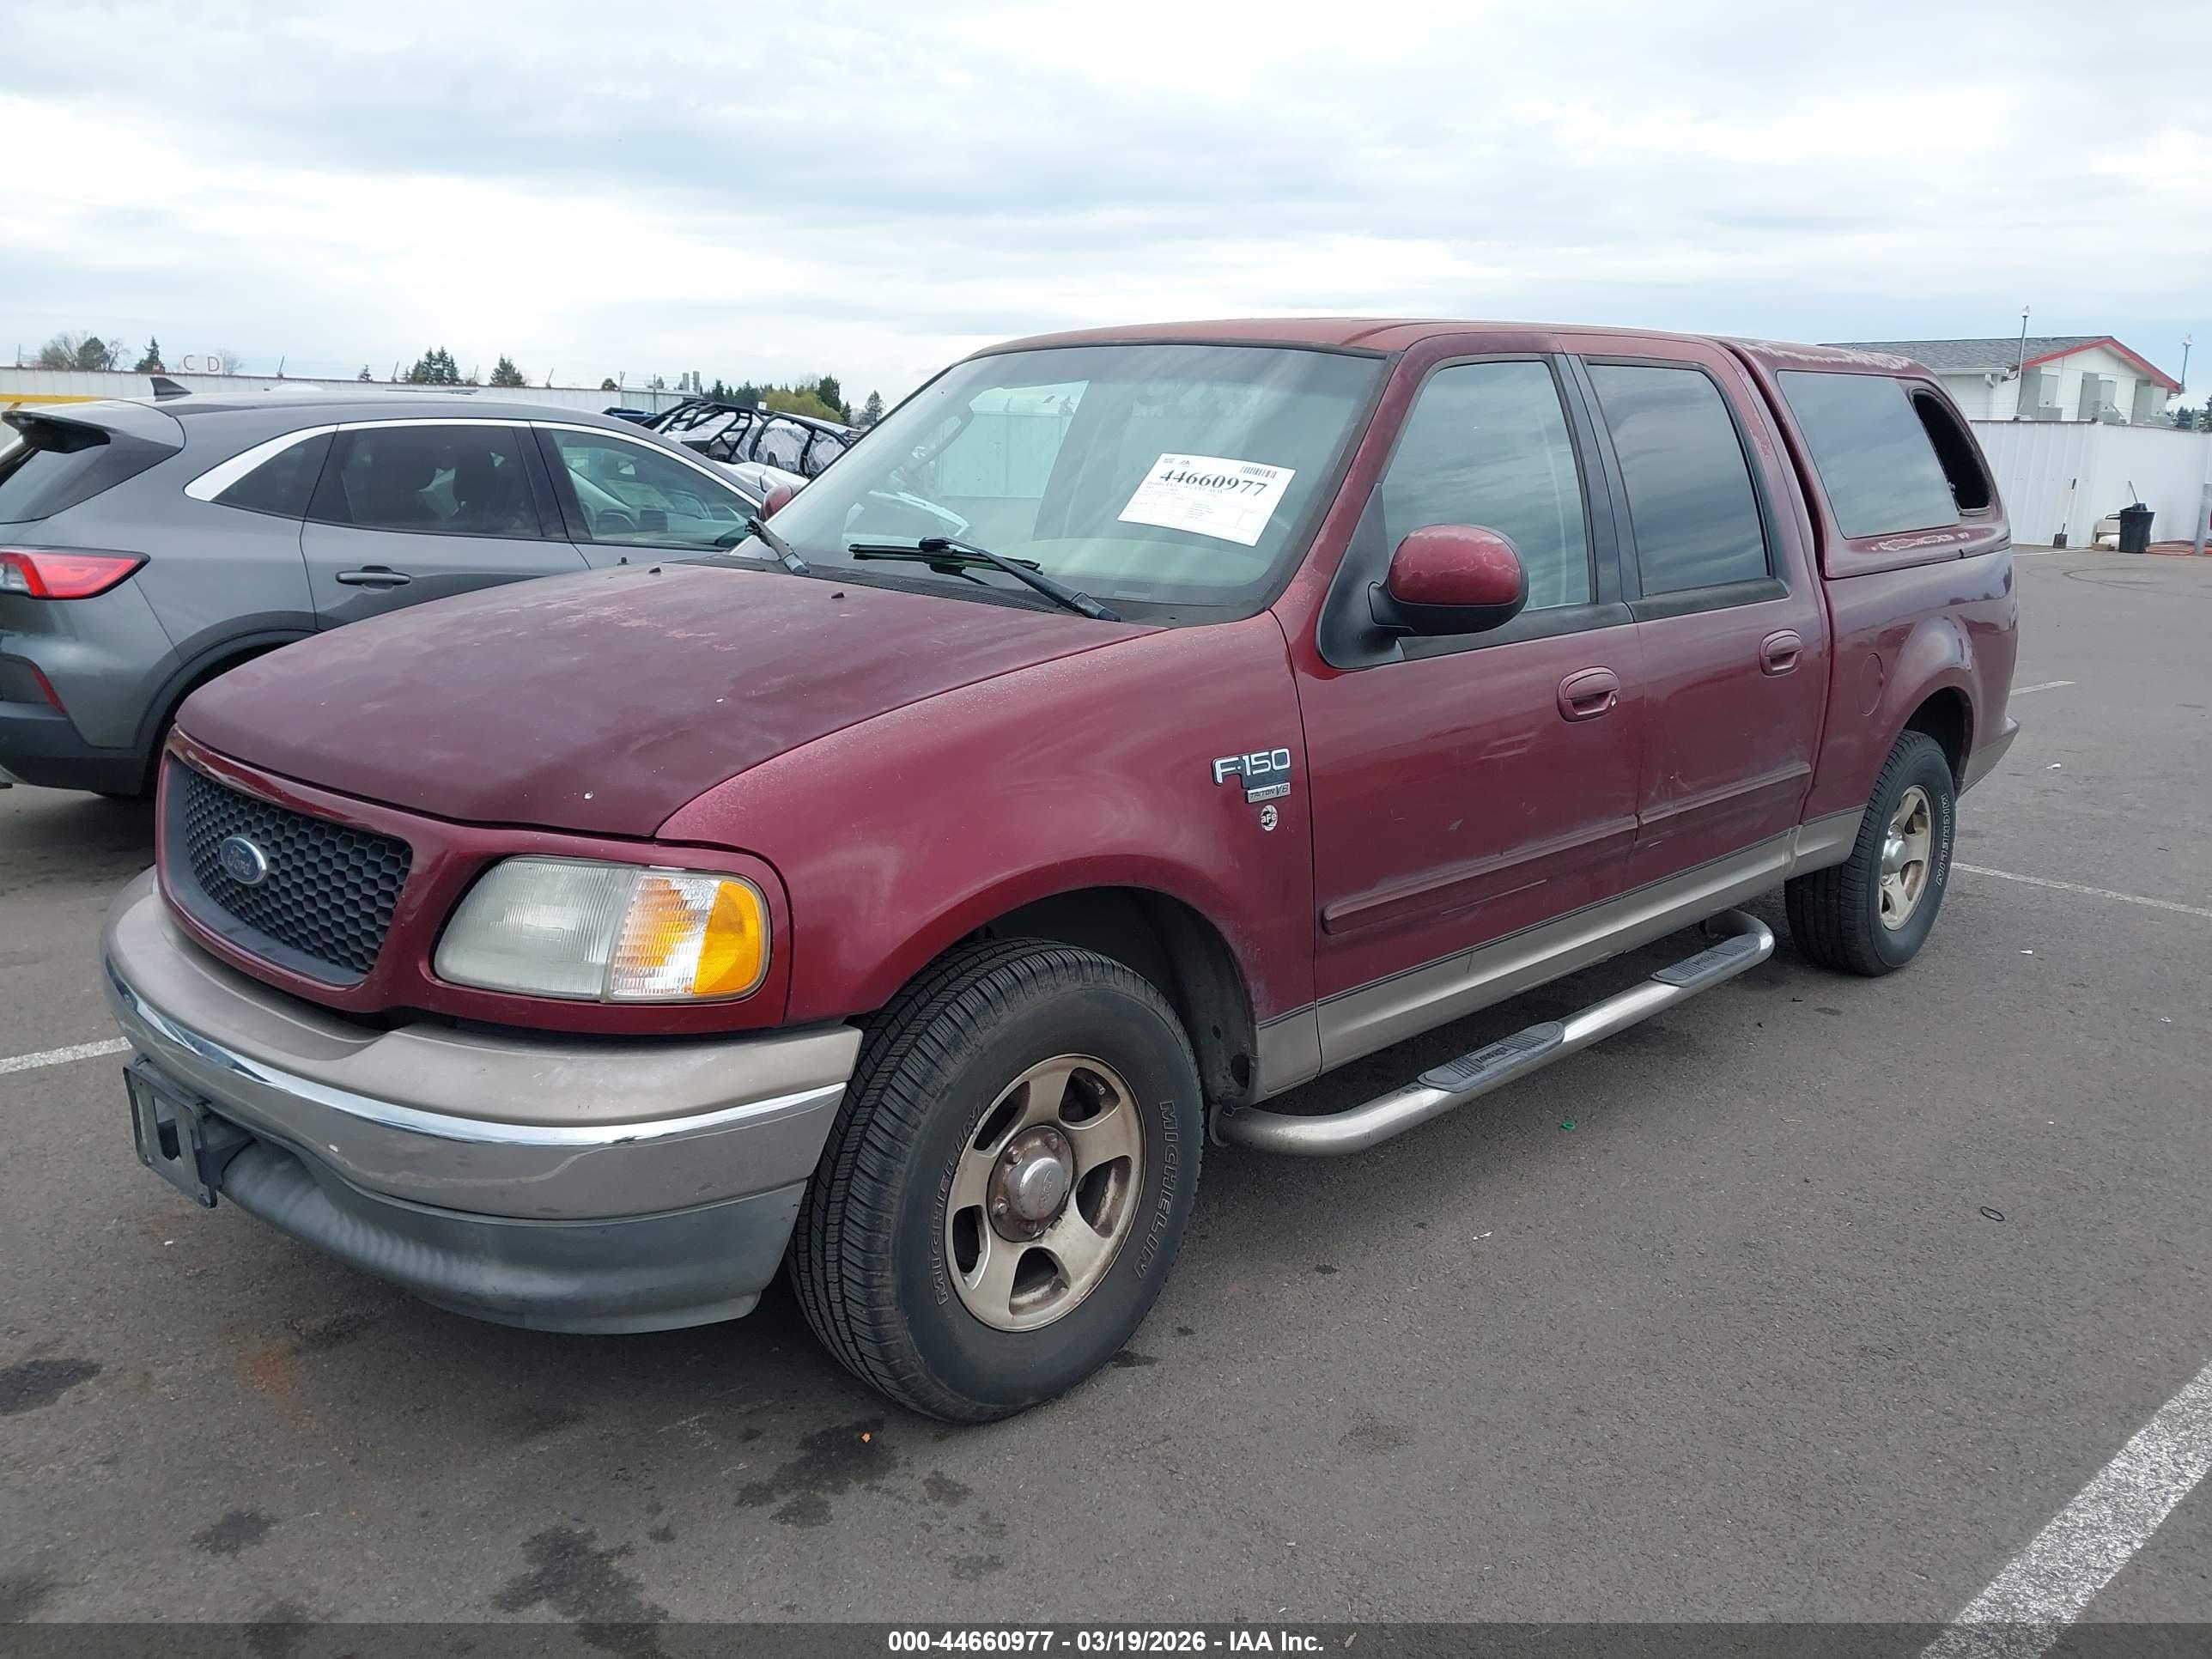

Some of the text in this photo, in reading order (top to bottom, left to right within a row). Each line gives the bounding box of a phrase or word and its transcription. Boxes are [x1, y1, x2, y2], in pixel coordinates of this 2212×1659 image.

[183, 354, 220, 372] C D
[1159, 469, 1267, 496] 44660977
[1249, 784, 1289, 799] TRITON V8
[1936, 792, 1951, 887] MICHELIN
[1133, 1100, 1180, 1279] MICHELIN
